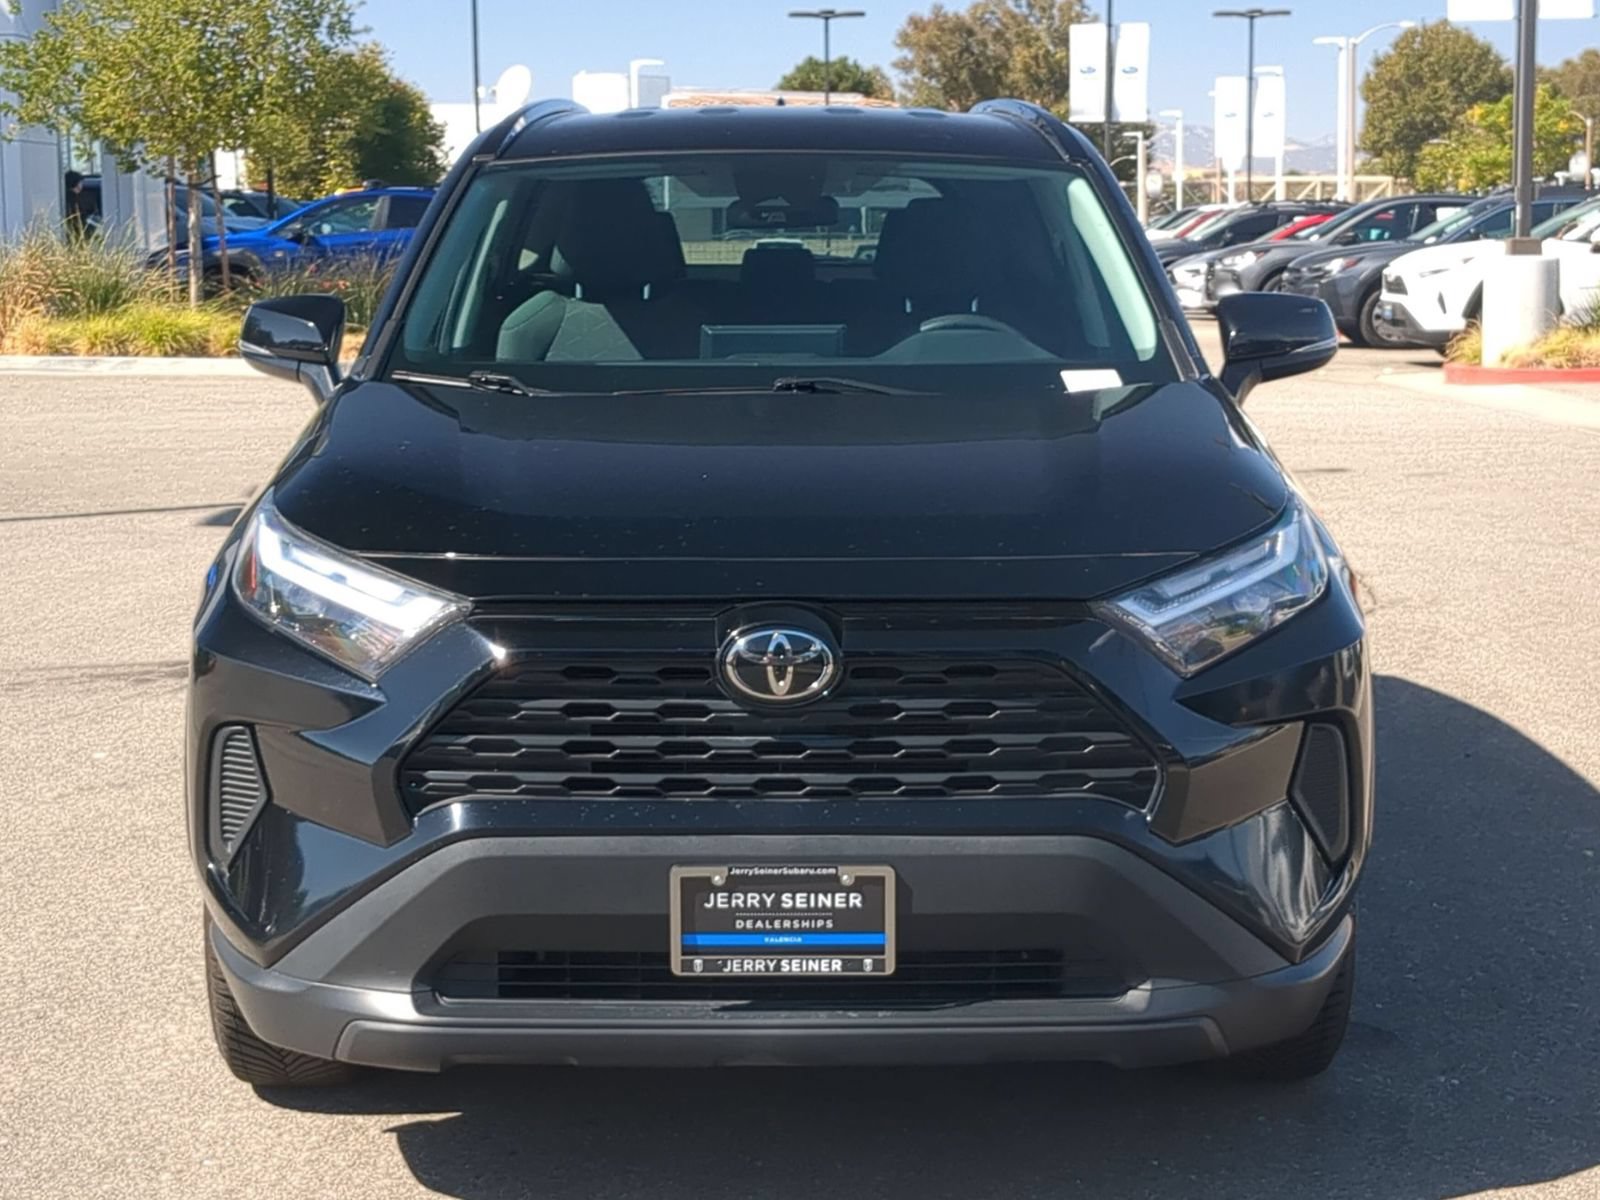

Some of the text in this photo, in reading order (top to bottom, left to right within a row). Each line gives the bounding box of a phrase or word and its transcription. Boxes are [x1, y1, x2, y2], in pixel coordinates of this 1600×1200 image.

[729, 867, 837, 876] JerrySeinerSubaru.com
[703, 892, 863, 909] JERRY SEINER
[735, 919, 834, 929] DEALERSHIPS
[722, 959, 842, 973] JERRY SEINER
